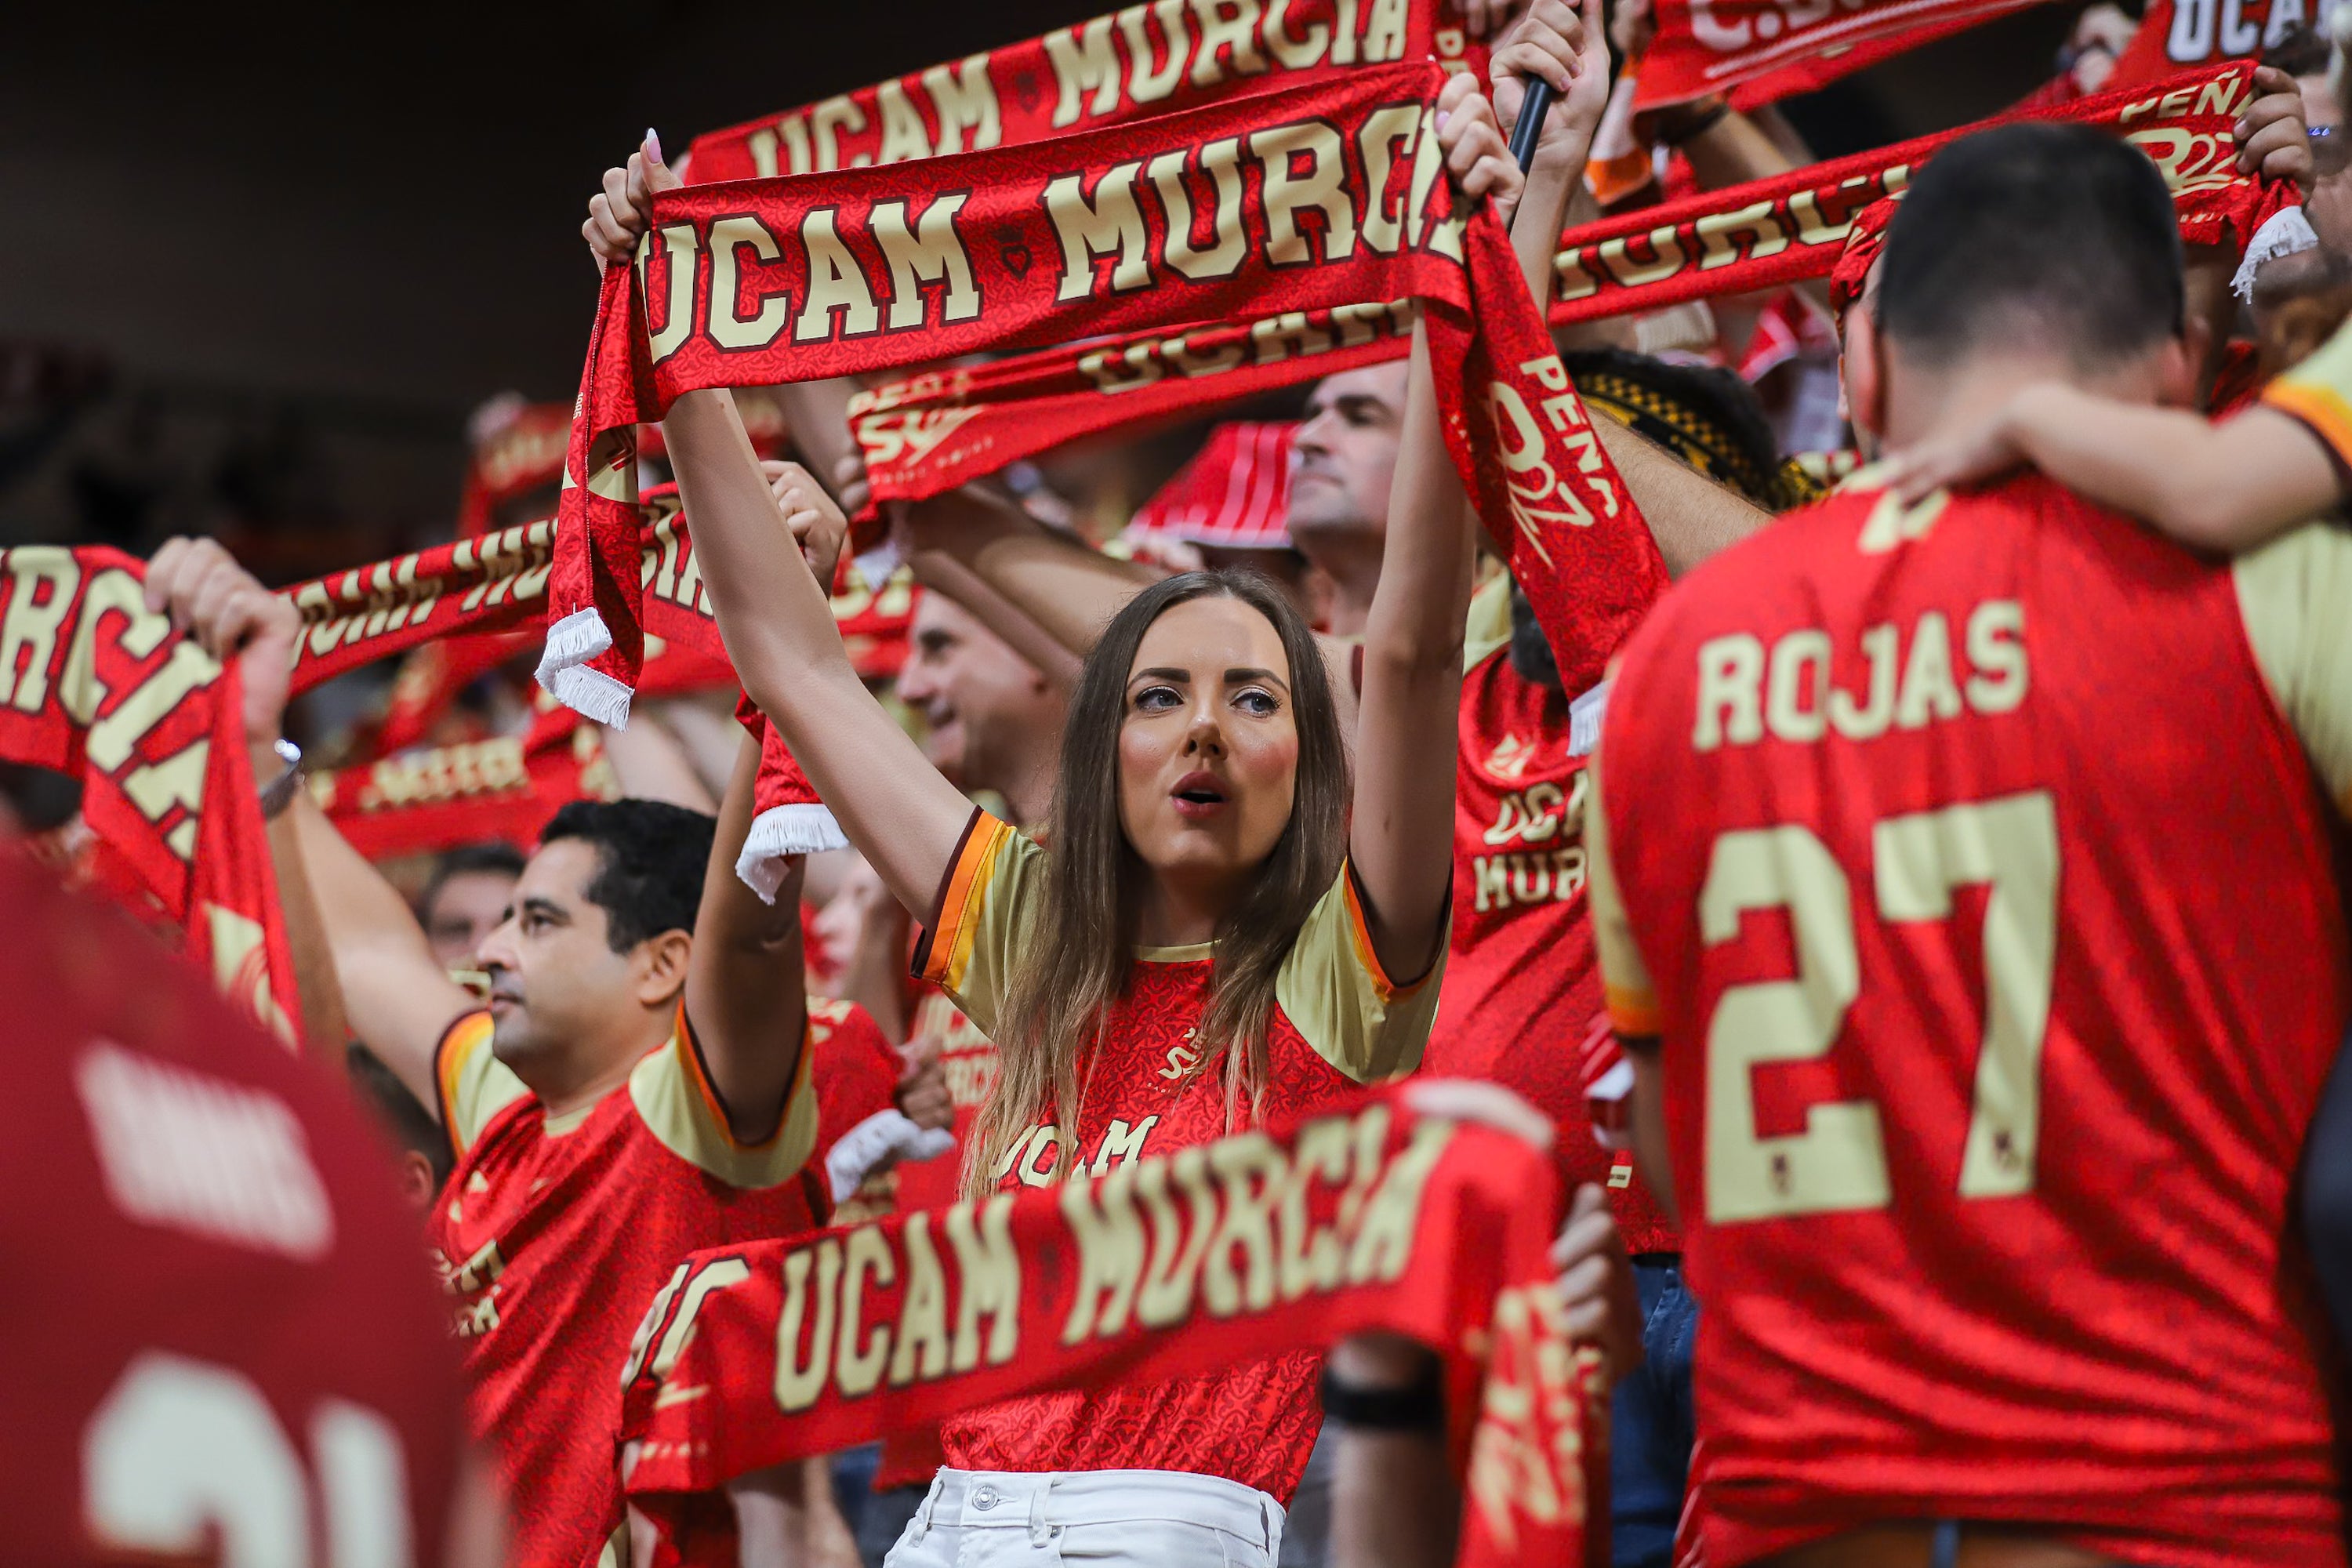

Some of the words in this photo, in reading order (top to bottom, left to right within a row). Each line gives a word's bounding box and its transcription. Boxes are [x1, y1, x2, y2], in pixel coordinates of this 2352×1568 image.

[747, 52, 1002, 177] UCAM
[1041, 0, 1411, 129] MURCIA
[635, 193, 985, 365] UCAM
[1693, 597, 2031, 751] ROJAS
[1697, 789, 2062, 1225] 27
[773, 1196, 1022, 1413] UCAM
[1058, 1104, 1452, 1345] MURCIA
